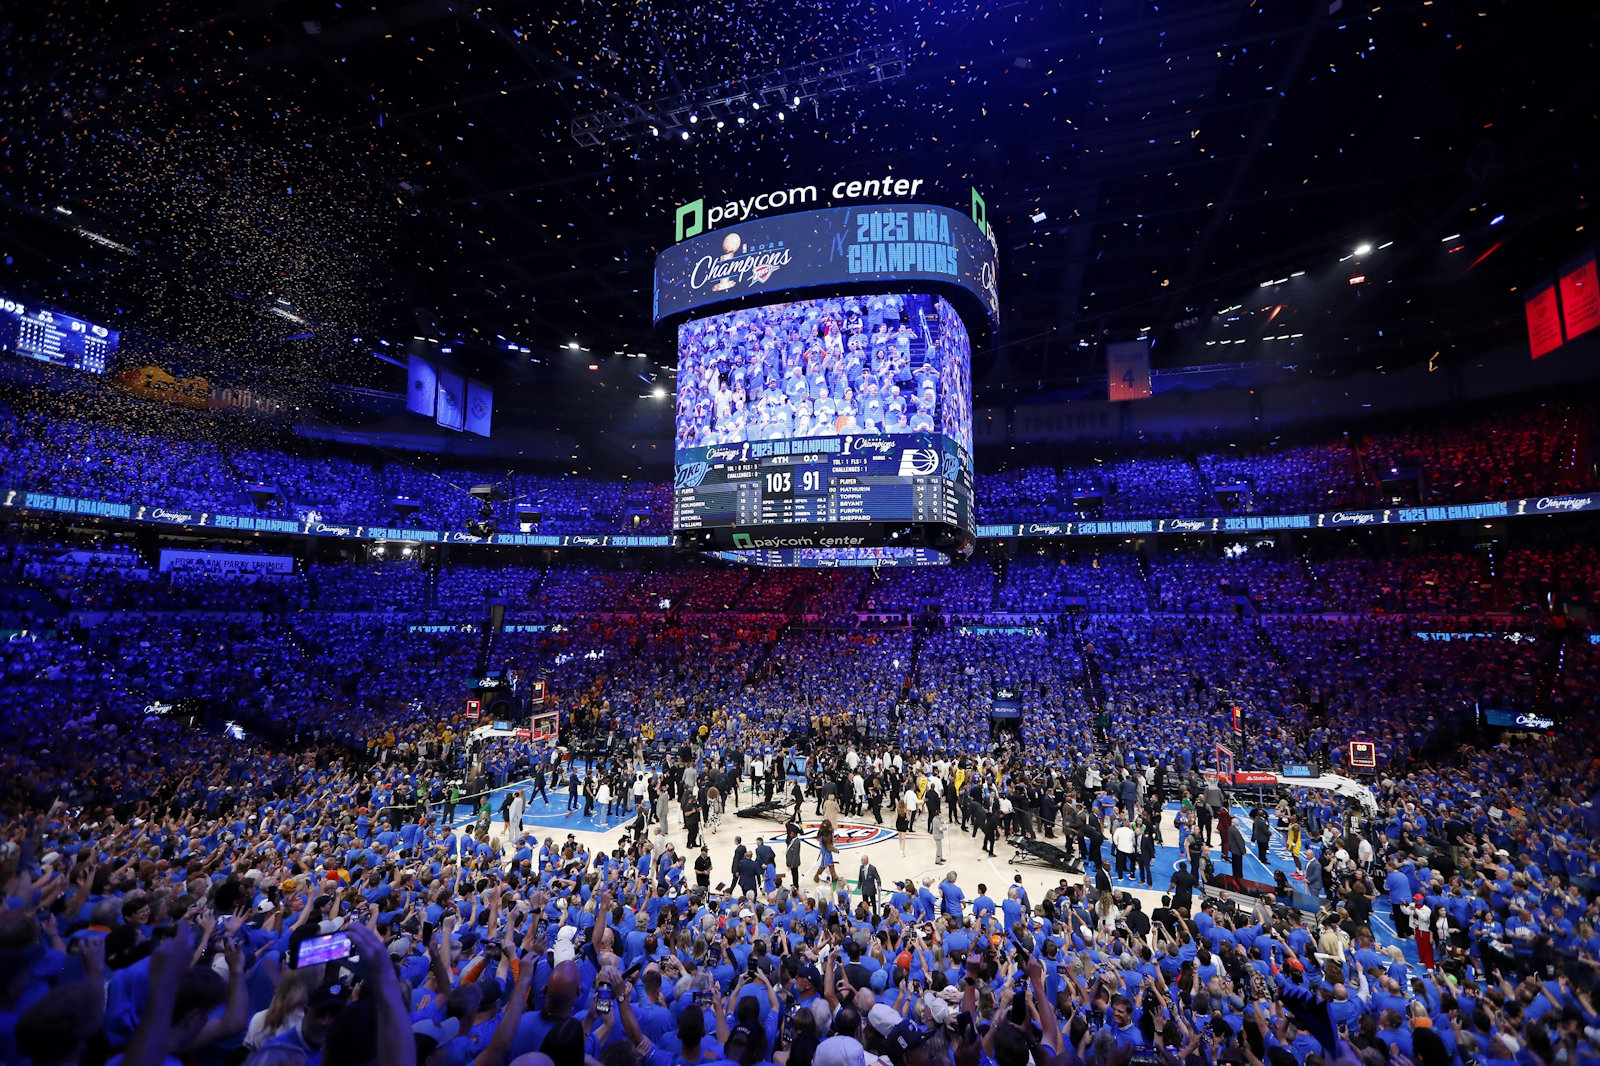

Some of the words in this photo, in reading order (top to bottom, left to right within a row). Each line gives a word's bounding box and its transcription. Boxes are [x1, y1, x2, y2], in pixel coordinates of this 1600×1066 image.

[707, 185, 817, 229] paycom
[832, 176, 923, 198] center
[857, 212, 908, 243] 2025
[913, 212, 949, 244] NBA
[750, 241, 784, 251] 2025
[691, 249, 792, 289] Champions
[849, 244, 958, 276] CHAMPIONS
[72, 321, 86, 333] 91
[1123, 368, 1135, 388] 4
[752, 443, 772, 457] 2025
[774, 442, 791, 456] NBA
[792, 439, 840, 455] CHAMPIONS
[854, 438, 896, 452] Champions
[772, 456, 789, 464] 4TH
[766, 473, 791, 493] 103
[803, 471, 819, 491] 91
[25, 493, 54, 509] 2025
[55, 496, 76, 512] NBA
[77, 499, 131, 518] CHAMPIONS
[152, 508, 192, 523] Champions
[215, 515, 238, 527] 2025
[238, 517, 254, 529] NBA
[255, 518, 299, 533] CHAMPIONS
[368, 527, 387, 538] 2025
[387, 528, 401, 539] NBA
[402, 529, 439, 541] CHAMPIONS
[498, 534, 514, 544] 2025
[515, 535, 526, 544] NBA
[527, 535, 560, 546] CHAMPIONS
[612, 536, 627, 546] 2025
[628, 536, 638, 546] NBA
[639, 536, 668, 546] CHAMPIONS
[976, 525, 1013, 536] CHAMPIONS
[1078, 522, 1096, 535] 2025
[1097, 522, 1111, 533] NBA
[1112, 520, 1152, 533] CHAMPIONS
[1225, 518, 1246, 529] 2025
[1246, 517, 1263, 529] NBA
[1263, 516, 1310, 529] CHAMPIONS
[1332, 512, 1374, 524] Champions
[1399, 508, 1425, 522] 2025
[1426, 507, 1447, 521] NBA
[1449, 502, 1508, 519] CHAMPIONS
[1536, 496, 1592, 510] Champions
[754, 537, 813, 548] paycom
[819, 536, 864, 546] center
